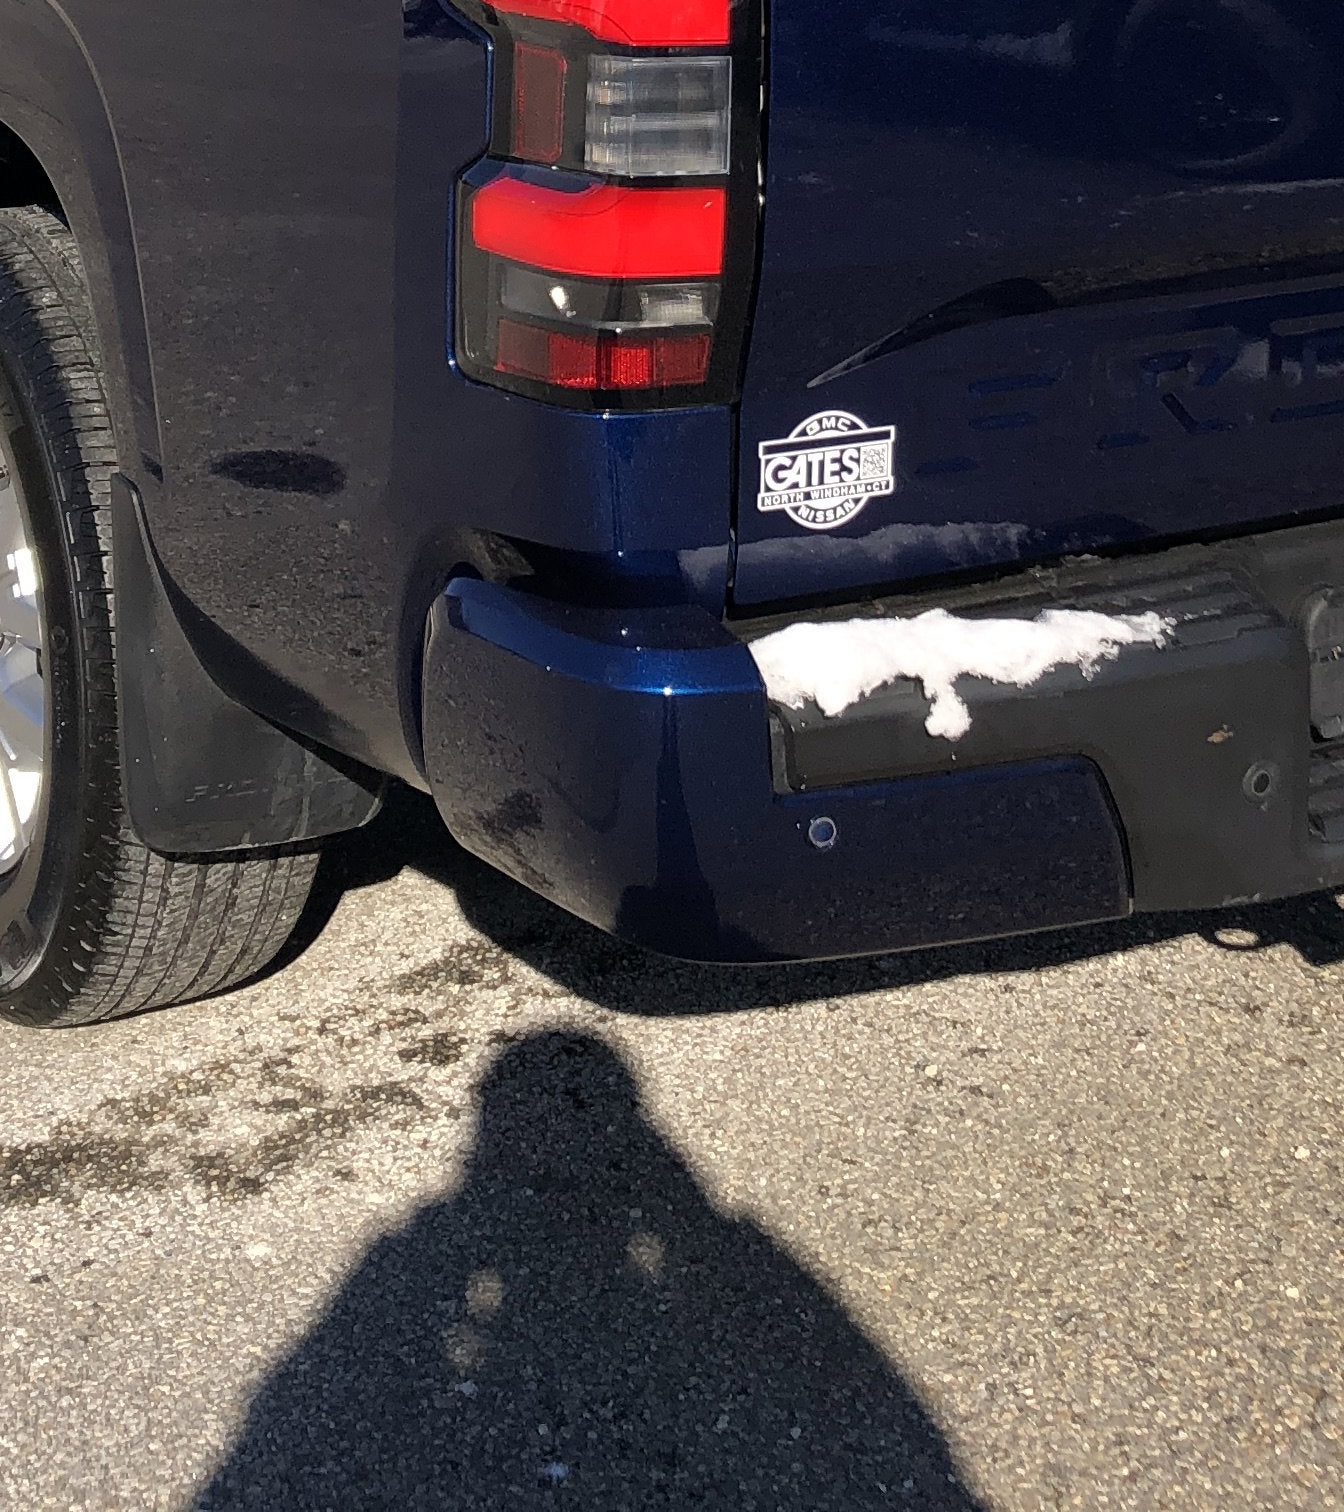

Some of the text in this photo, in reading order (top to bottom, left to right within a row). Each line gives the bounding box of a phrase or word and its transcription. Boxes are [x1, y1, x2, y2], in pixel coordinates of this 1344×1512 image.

[765, 448, 860, 491] GATES
[764, 491, 804, 506] NORTH
[798, 498, 855, 522] NISSAN
